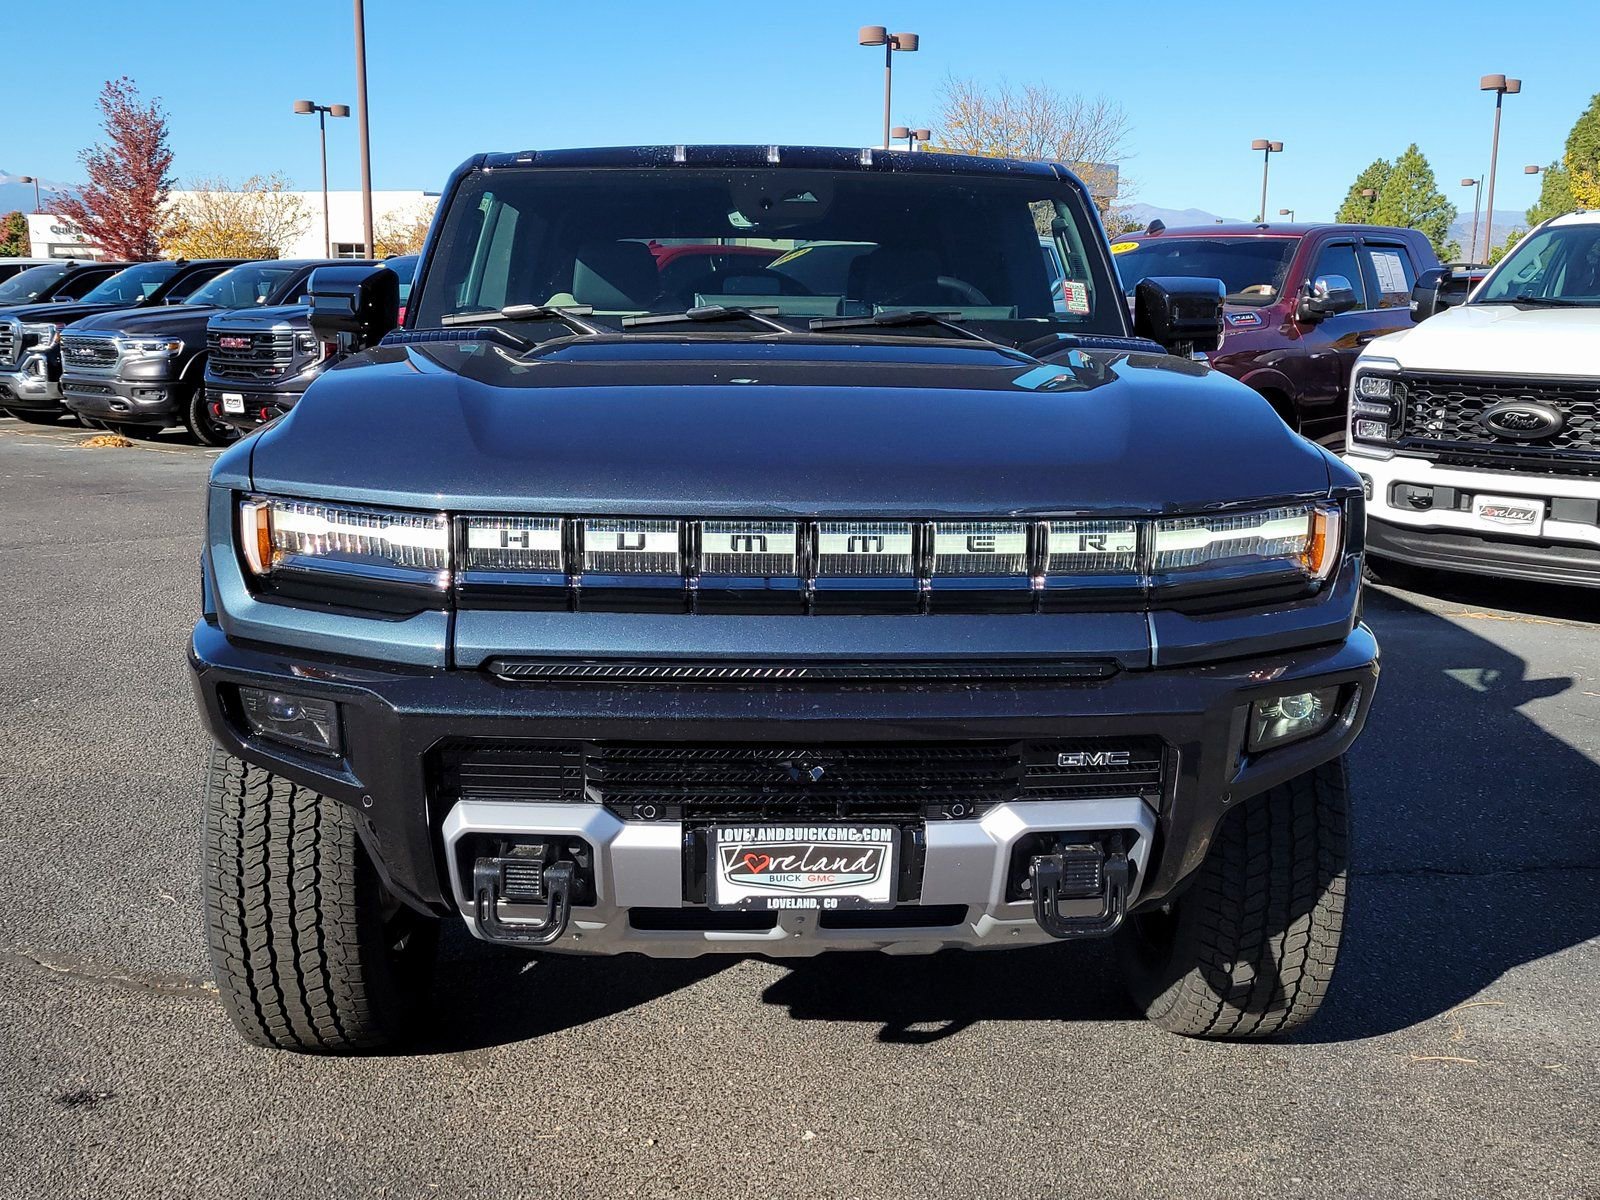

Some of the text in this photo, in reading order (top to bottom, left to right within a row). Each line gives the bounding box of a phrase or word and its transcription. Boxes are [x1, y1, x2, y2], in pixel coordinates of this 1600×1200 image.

[1501, 411, 1539, 429] Ford
[1057, 751, 1130, 767] GMC
[717, 827, 892, 843] LOVELANDBUICKGMC.COM
[769, 874, 836, 883] BUICK GMC
[767, 898, 838, 910] LOVELAND, CO
